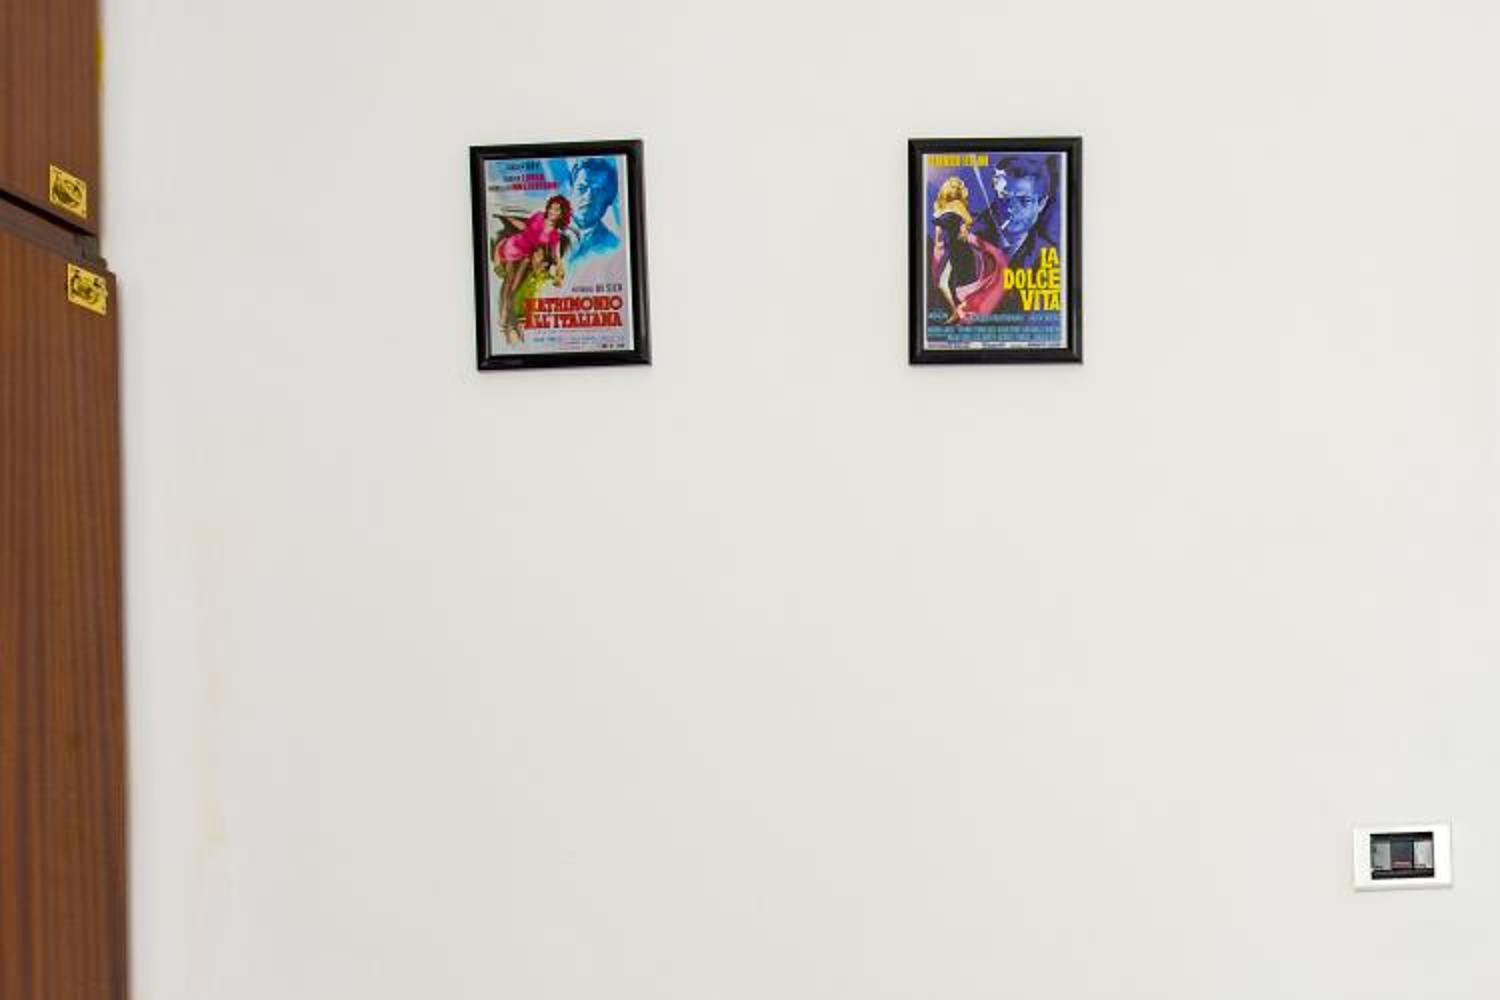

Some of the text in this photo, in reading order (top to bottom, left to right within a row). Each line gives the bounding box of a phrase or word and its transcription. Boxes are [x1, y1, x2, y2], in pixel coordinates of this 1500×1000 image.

[1040, 247, 1060, 269] LA
[1003, 268, 1062, 289] DOLCE
[1020, 289, 1062, 311] VITA
